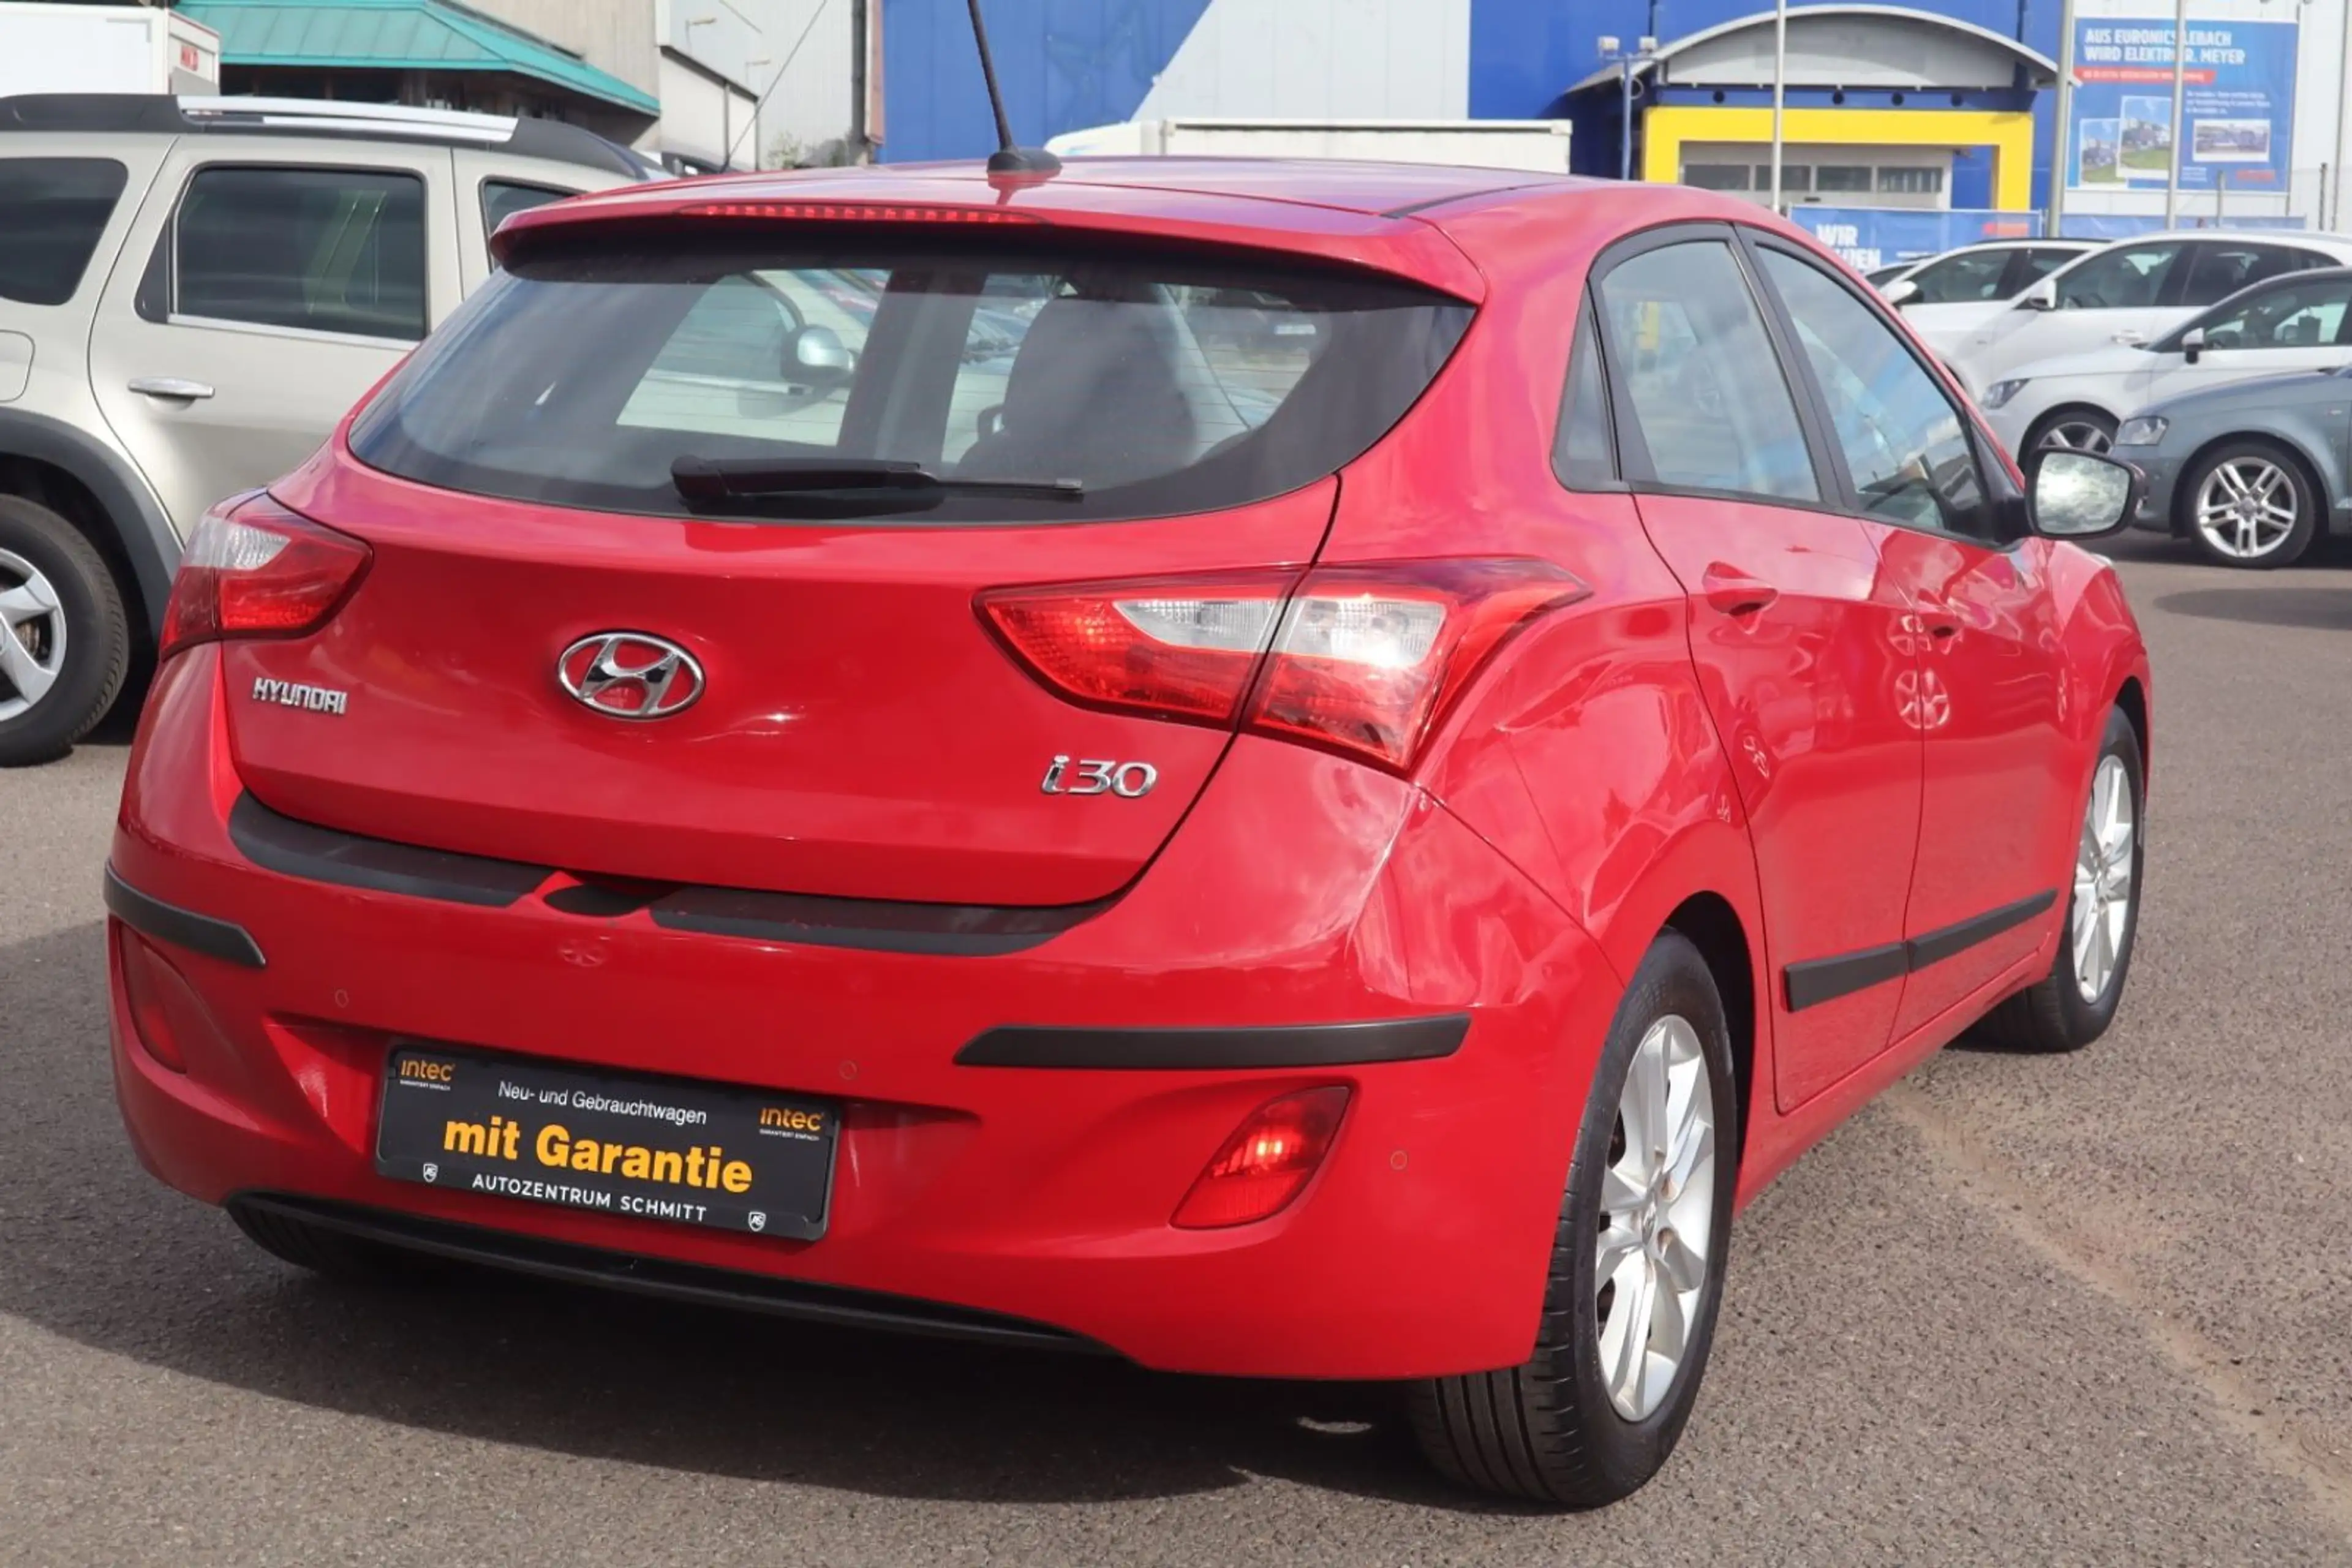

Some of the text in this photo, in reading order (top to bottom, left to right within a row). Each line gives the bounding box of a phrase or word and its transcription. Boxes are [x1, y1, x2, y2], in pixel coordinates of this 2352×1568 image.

[2085, 29, 2111, 44] AUS
[2084, 45, 2122, 61] WIRD
[2199, 48, 2246, 65] MEYER
[1816, 224, 1858, 247] WIR
[253, 676, 348, 715] HYUNDAI
[1041, 755, 1158, 797] i30
[401, 1059, 453, 1082] intec
[499, 1080, 707, 1126] Neu- und Gebrauchtwagen
[760, 1107, 823, 1131] intec
[444, 1115, 753, 1193] mit Garantie
[472, 1173, 707, 1222] AUTOZENTRUM SCHMITT
